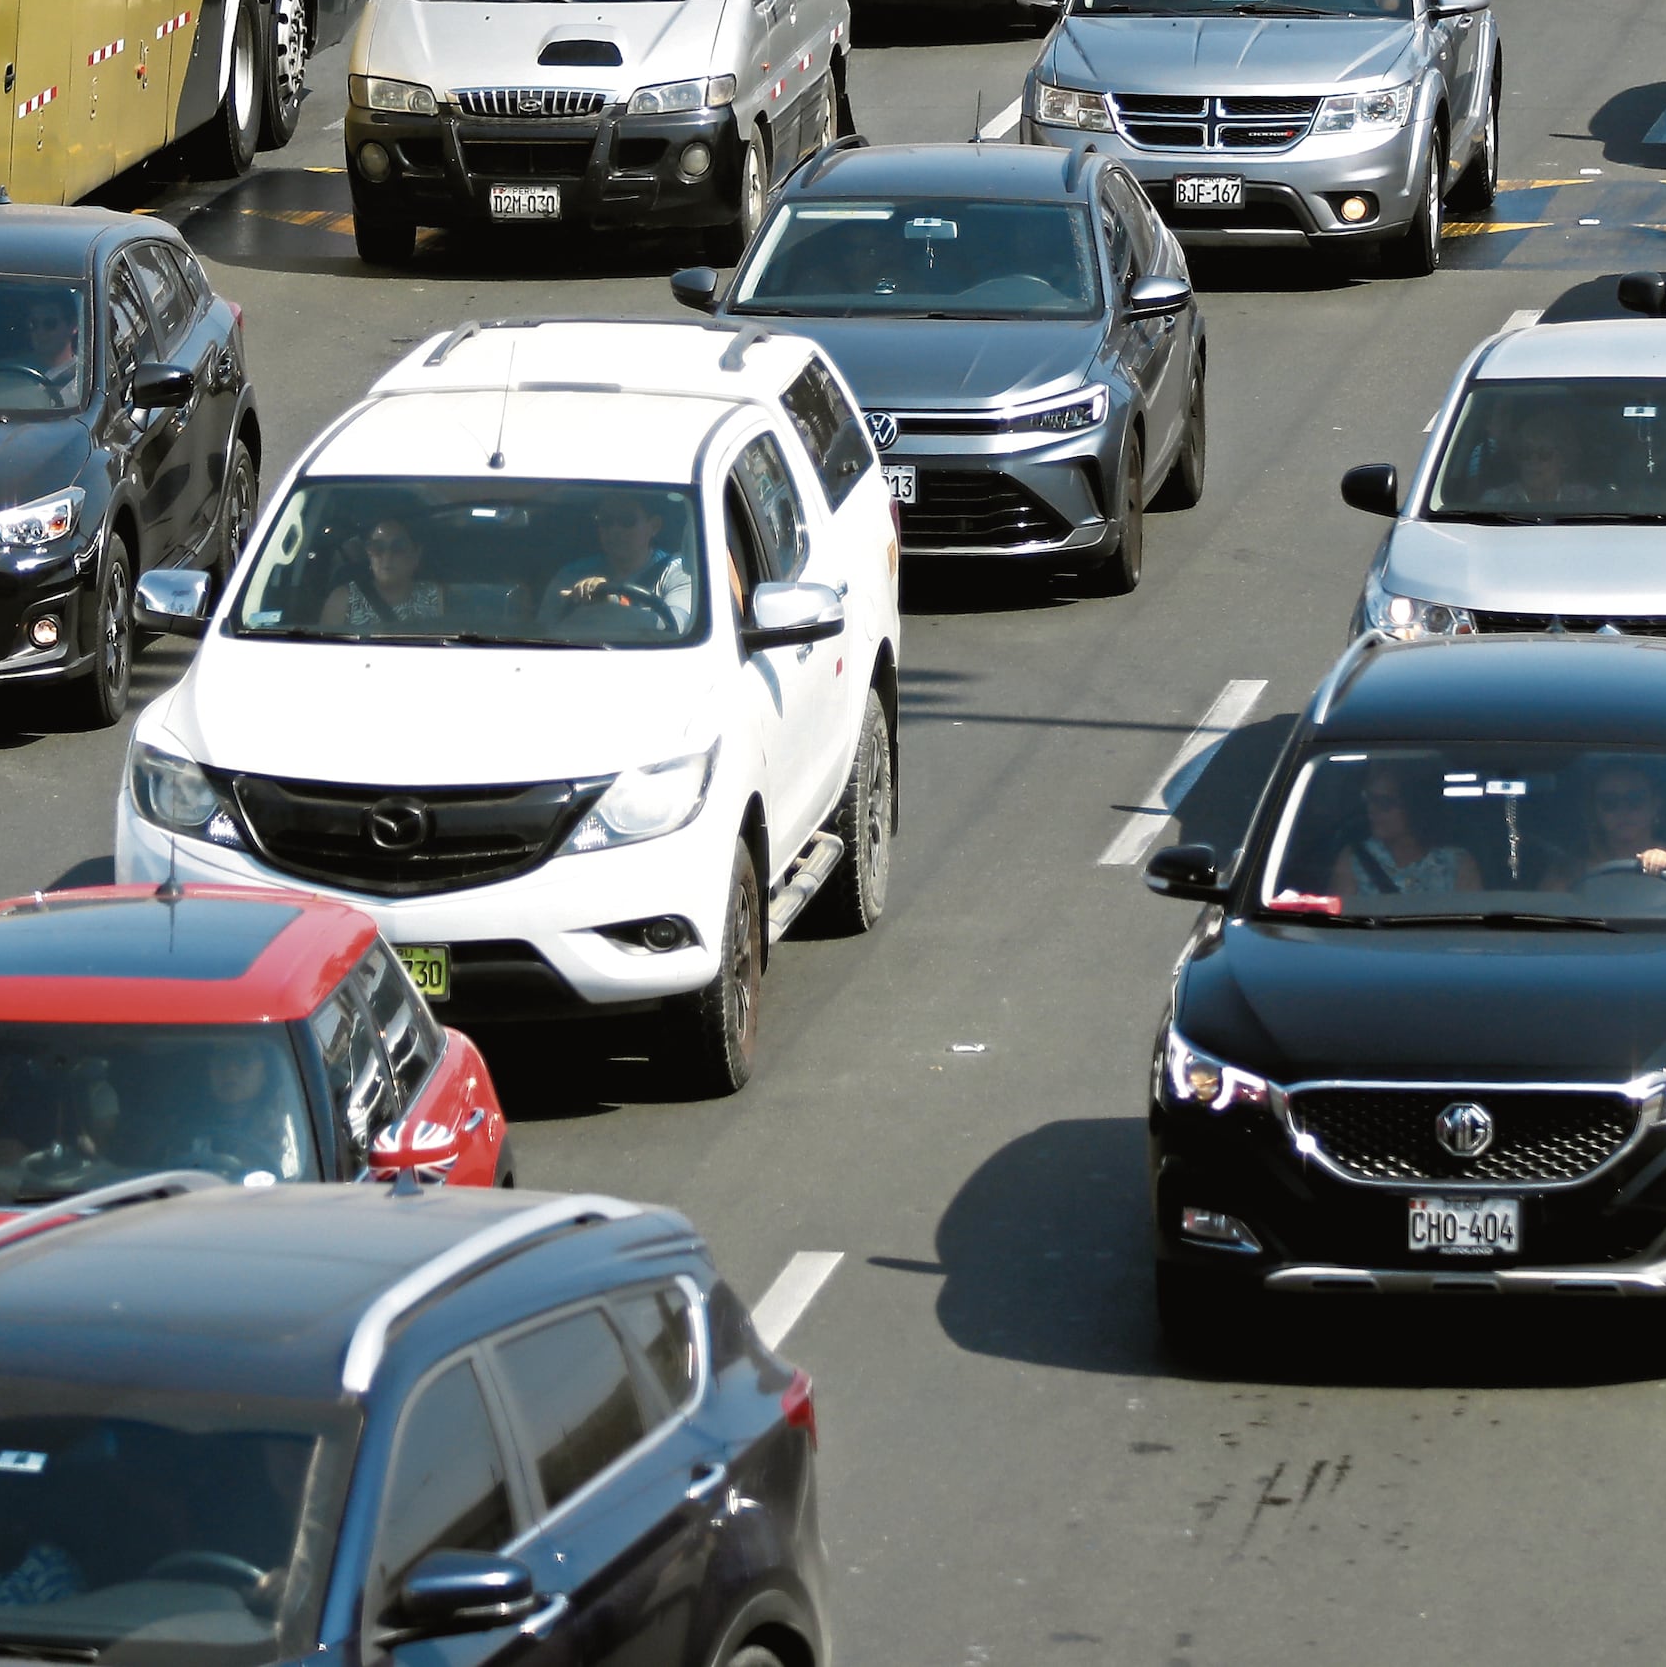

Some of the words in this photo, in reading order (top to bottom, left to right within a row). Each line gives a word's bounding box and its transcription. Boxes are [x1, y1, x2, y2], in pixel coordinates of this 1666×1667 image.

[513, 187, 536, 195] PERU
[1177, 184, 1240, 204] BJF-167
[494, 195, 555, 215] D2M-030
[1443, 1200, 1483, 1211] PERU
